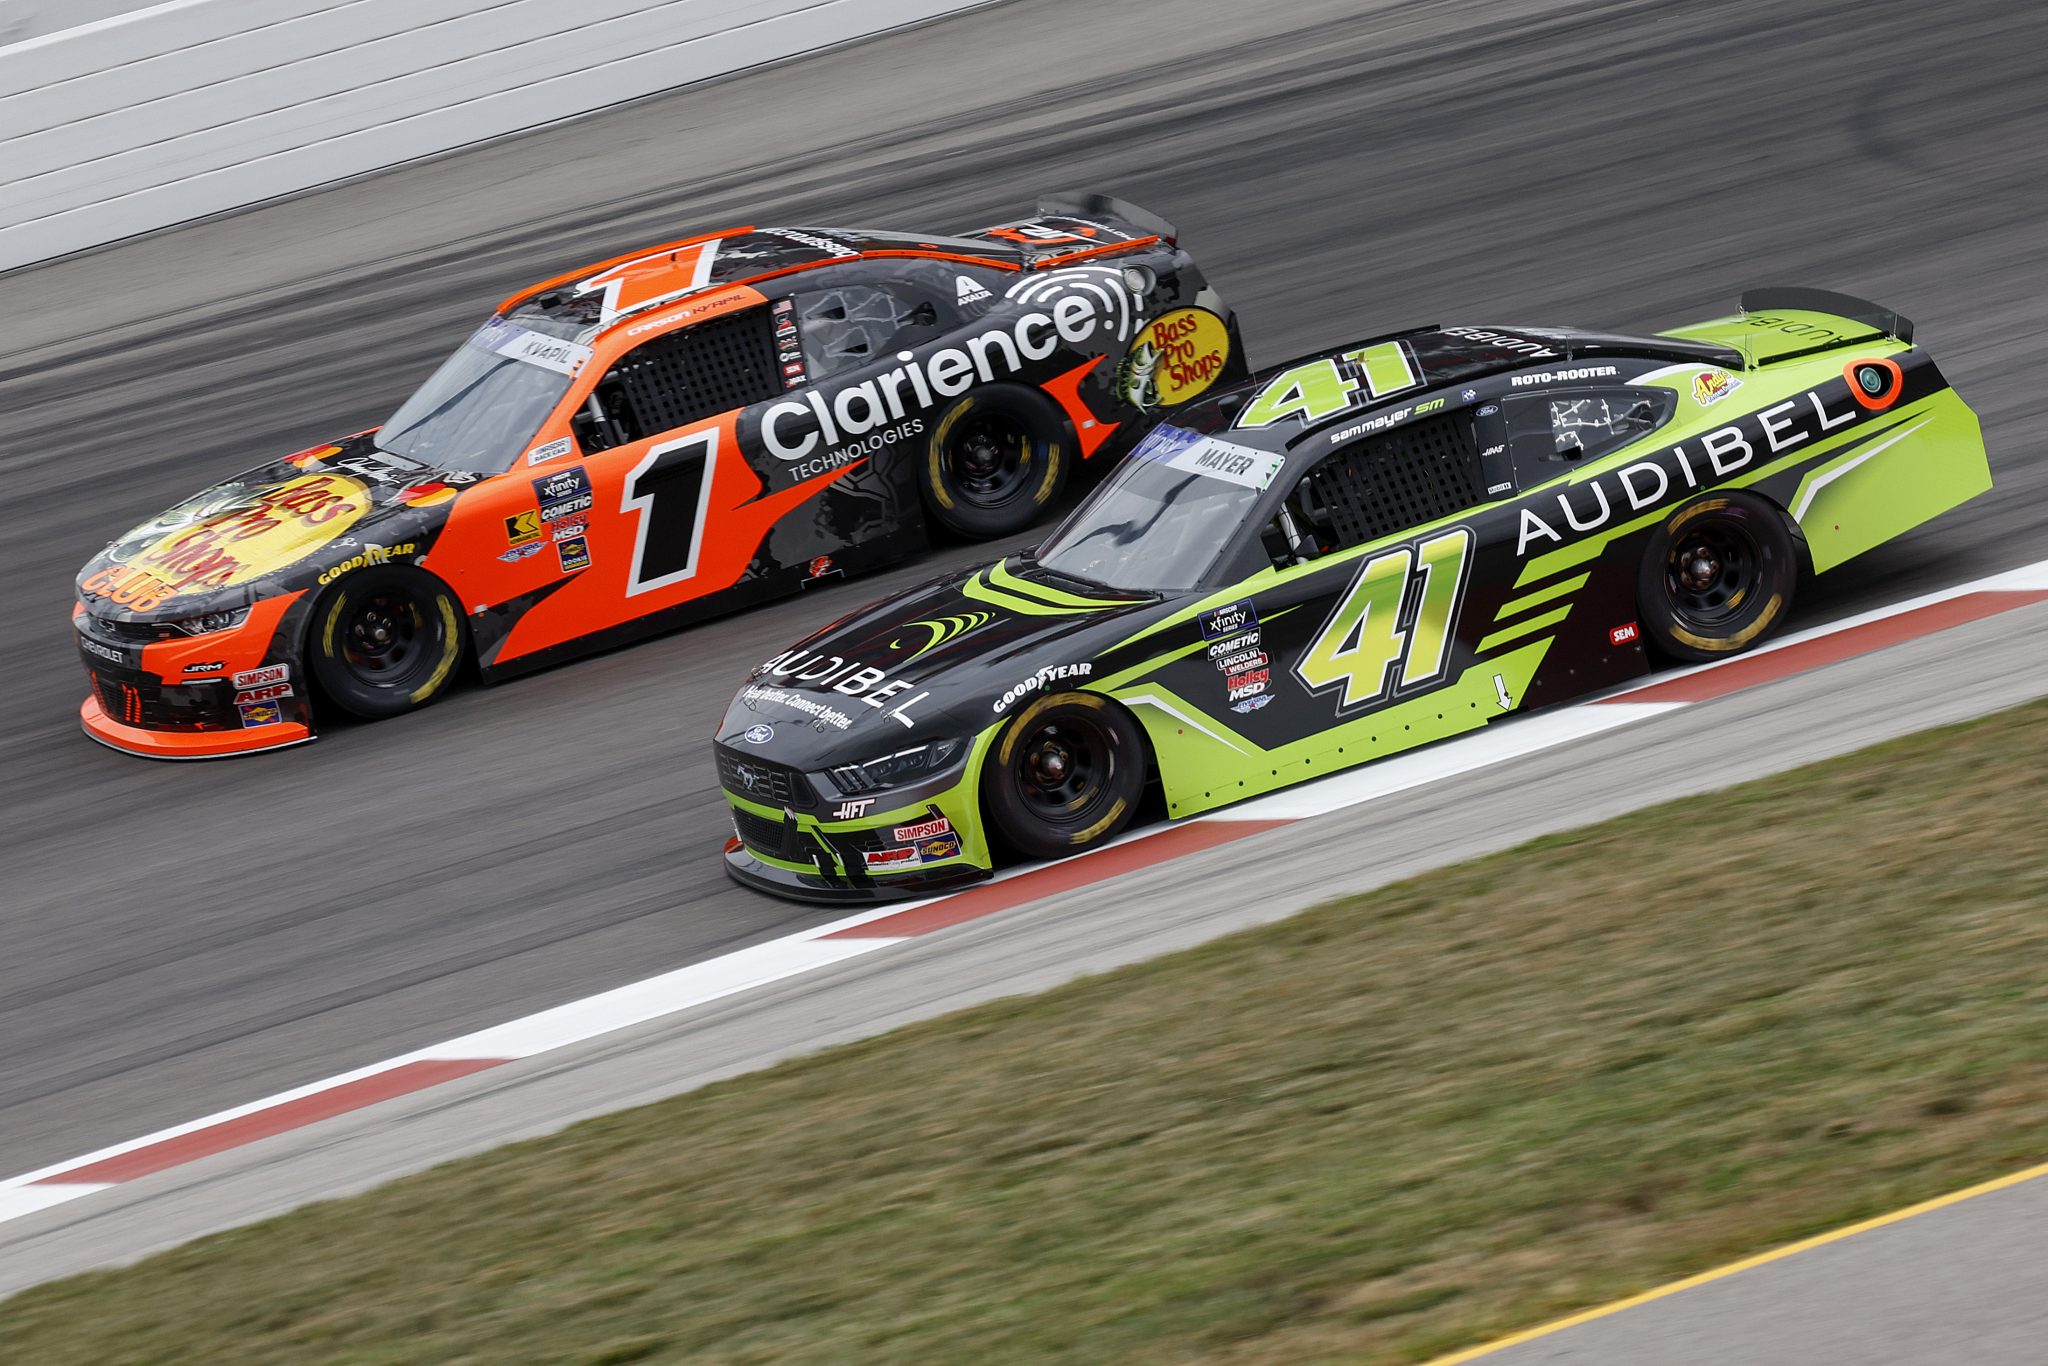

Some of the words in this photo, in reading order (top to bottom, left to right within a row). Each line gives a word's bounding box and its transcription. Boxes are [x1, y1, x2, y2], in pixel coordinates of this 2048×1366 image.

[573, 238, 723, 324] 1
[957, 290, 993, 306] AXALTA
[1151, 312, 1198, 352] Bass
[1443, 326, 1559, 358] AUDIBE
[521, 340, 572, 364] KVAPIL
[1162, 337, 1196, 372] Pro
[759, 294, 1097, 461] Clarience
[1169, 349, 1223, 392] Shops
[1511, 365, 1618, 387] ROTO-ROOTER
[1236, 340, 1417, 429] 41
[552, 447, 567, 457] CAR
[788, 418, 925, 482] TECHNOLOGIES
[1195, 448, 1255, 476] MAYER
[1516, 391, 1857, 556] AUDIBEL
[543, 477, 580, 497] xfinity
[259, 476, 357, 525] Bass
[541, 495, 592, 520] COMETIC
[619, 425, 720, 598] 1
[203, 502, 283, 543] Pro
[552, 524, 585, 542] MSD
[144, 529, 241, 590] Shops
[317, 543, 416, 585] GOODYEAR
[81, 564, 179, 613] CLUB
[1209, 611, 1247, 632] xfinity
[1295, 528, 1471, 708] 41
[1209, 632, 1259, 657] COMETIC
[1613, 626, 1635, 642] SEM
[81, 636, 124, 664] CHEVROLET
[1218, 650, 1258, 669] LINCOLN
[183, 662, 223, 673] JRM
[237, 667, 284, 687] SIMPSON
[1228, 657, 1263, 673] WELDERS
[761, 650, 931, 729] AUDIBEL
[992, 662, 1092, 714] GOODYEAR
[1227, 667, 1270, 692] Holley
[1228, 681, 1266, 702] MSD
[235, 684, 290, 704] ARP
[742, 685, 764, 699] Hear
[785, 694, 826, 717] Connect
[819, 706, 853, 730] better.
[832, 798, 876, 820] HFT
[897, 820, 947, 840] SIMPSON
[866, 847, 916, 864] ARP
[920, 840, 957, 856] SUNOCO
